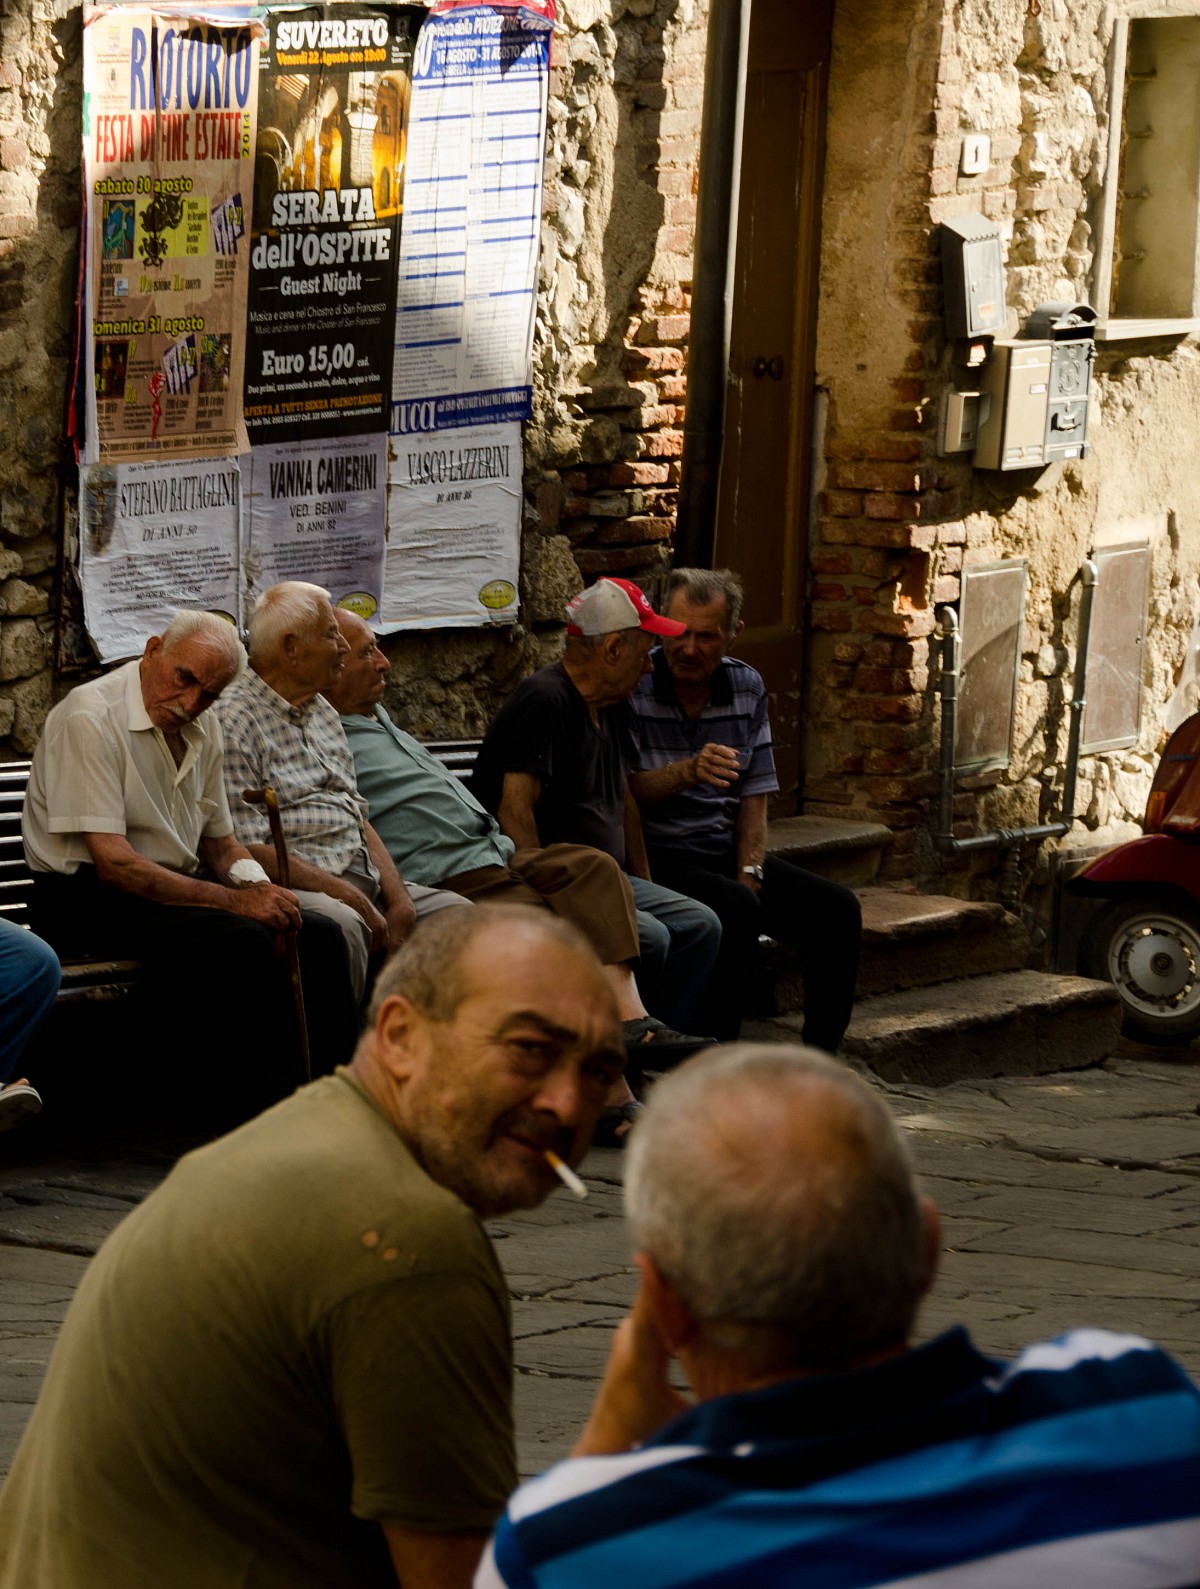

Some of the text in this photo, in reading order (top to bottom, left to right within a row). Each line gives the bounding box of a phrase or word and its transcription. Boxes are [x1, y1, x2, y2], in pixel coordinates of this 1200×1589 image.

[276, 18, 389, 50] SUVERETO
[131, 27, 251, 110] RIOTORTO
[350, 52, 363, 63] ore
[447, 48, 477, 63] AGOSTO
[481, 48, 490, 62] 31
[491, 45, 520, 61] AGOSTO
[96, 112, 241, 163] FESTA DI FINE ESTATE
[242, 112, 251, 159] 2014
[95, 175, 193, 195] sabato 30 agosto
[272, 188, 376, 226] SERATA
[252, 228, 391, 270] dell'OSPITE
[280, 271, 362, 297] Guest Night
[342, 303, 355, 315] San
[356, 301, 387, 314] Francesco
[150, 316, 162, 334] 31
[165, 315, 204, 336] agosto
[262, 349, 305, 376] Euro
[308, 342, 355, 376] 15,00
[244, 404, 273, 418] APERTA
[274, 403, 280, 415] A
[281, 401, 304, 414] TUTTI
[269, 453, 377, 499] VANNA CAMERINI
[407, 445, 510, 486] VASCO LAZZERINI
[121, 472, 237, 518] STEFANO BATTAGLINI
[315, 501, 347, 517] BENINI
[142, 527, 156, 541] DI
[158, 525, 183, 540] ANNI
[296, 522, 305, 533] DI
[307, 520, 325, 532] ANNI
